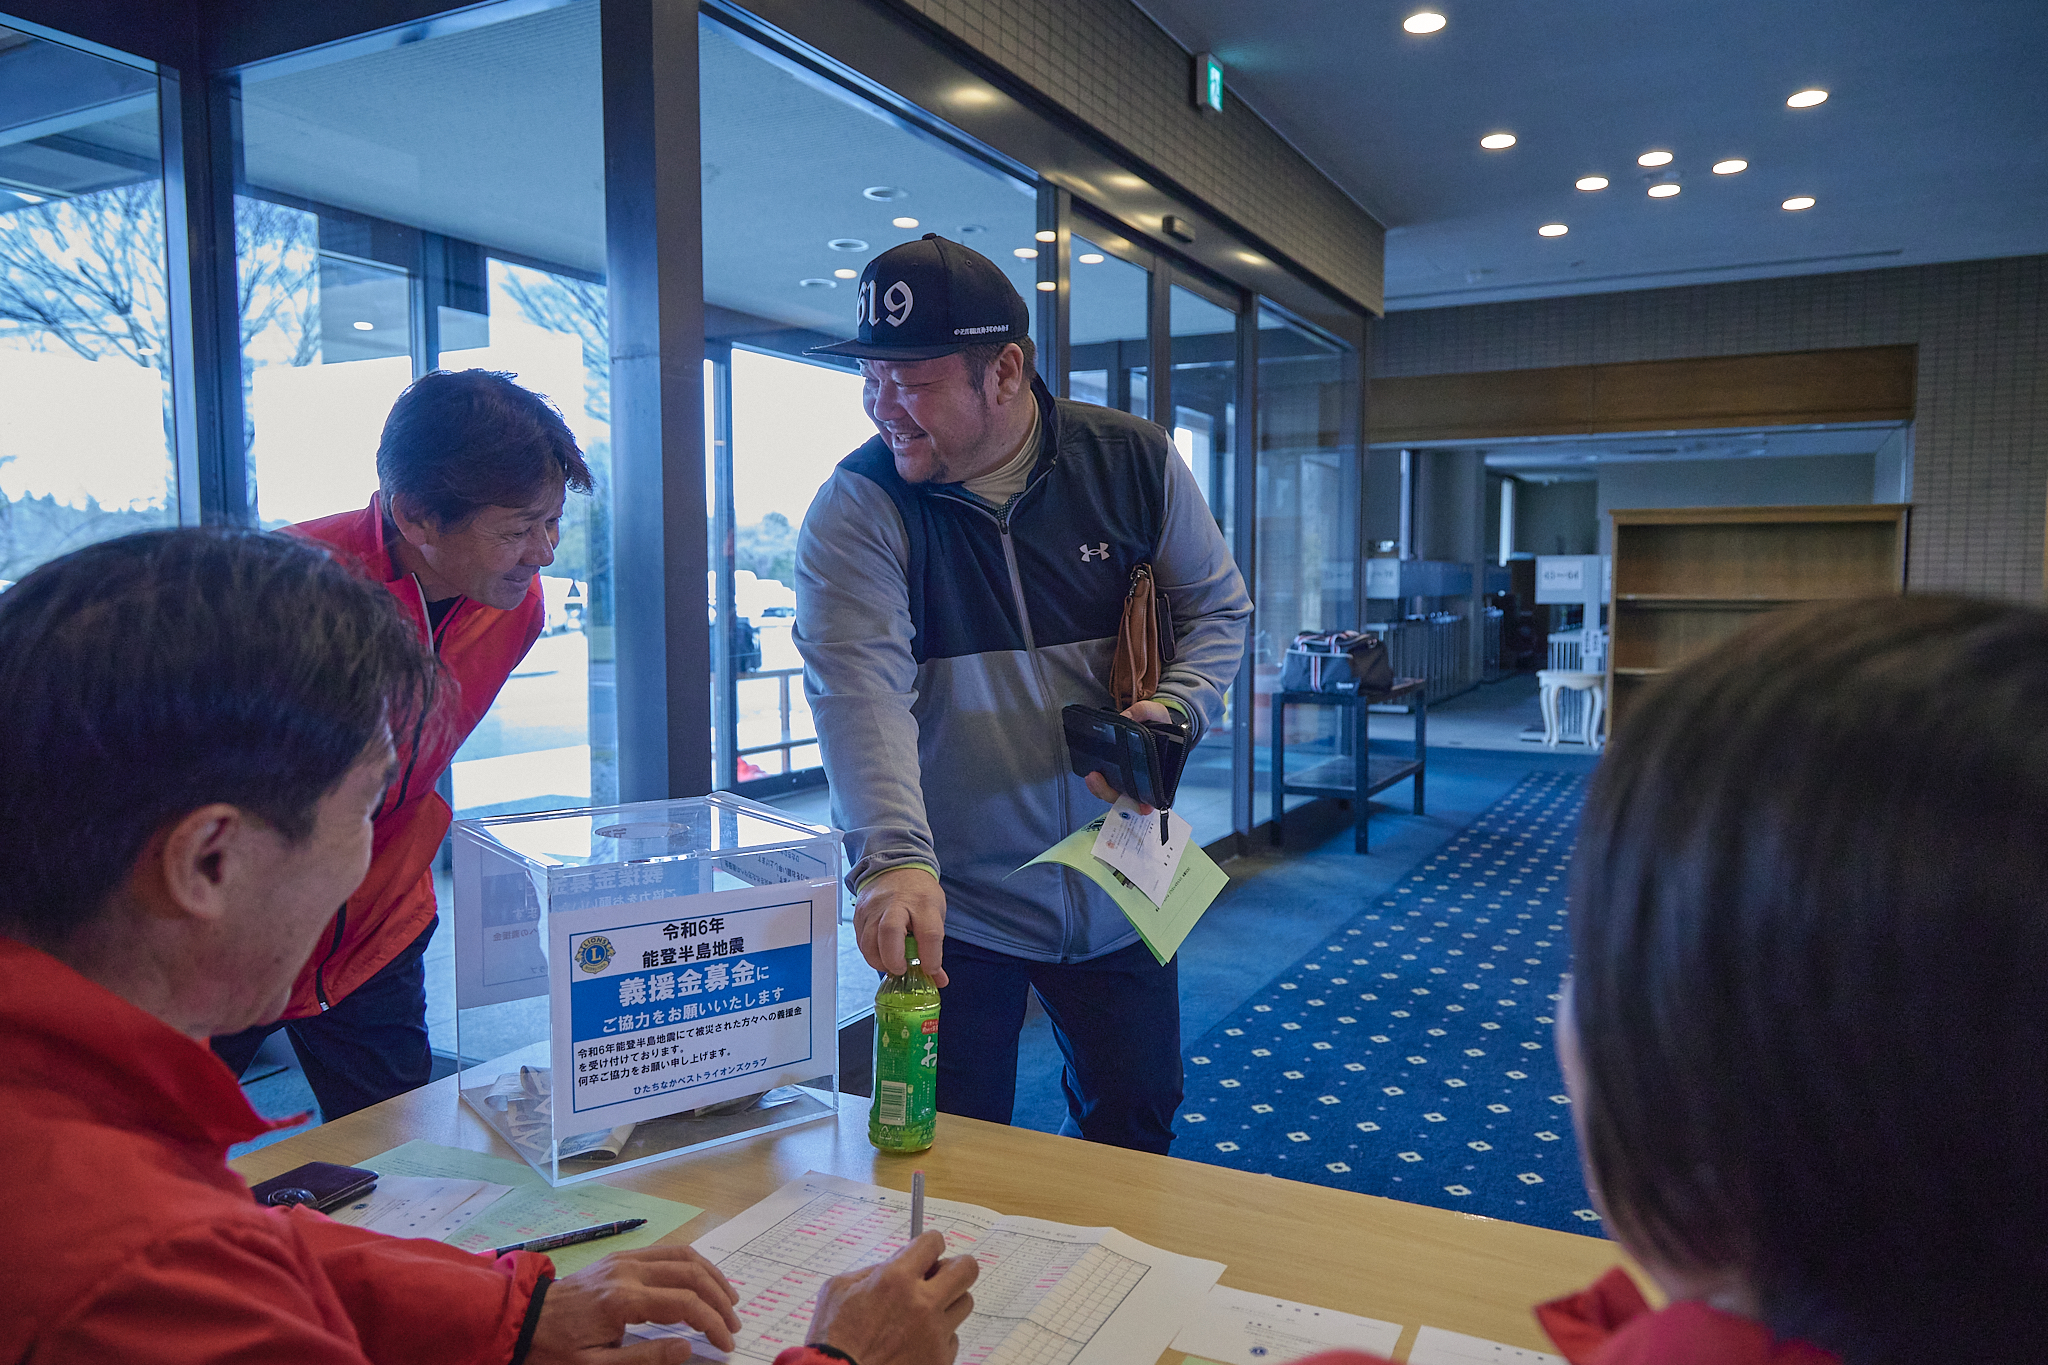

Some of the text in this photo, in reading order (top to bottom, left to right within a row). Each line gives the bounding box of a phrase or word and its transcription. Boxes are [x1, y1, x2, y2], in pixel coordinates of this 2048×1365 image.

[584, 937, 607, 947] LIONS
[662, 917, 725, 941] 令和6年
[591, 948, 602, 962] L
[642, 936, 745, 968] 能登半島地震
[619, 959, 770, 1007] 義援金募金に
[602, 987, 785, 1033] ご協力をお願いいたします
[577, 1006, 803, 1060] 令和6年能登半島地震にて被災された方々への義援金
[577, 1048, 731, 1087] 何卒ご協力をお願い申し上げます。
[578, 1045, 685, 1072] を受け付けております。
